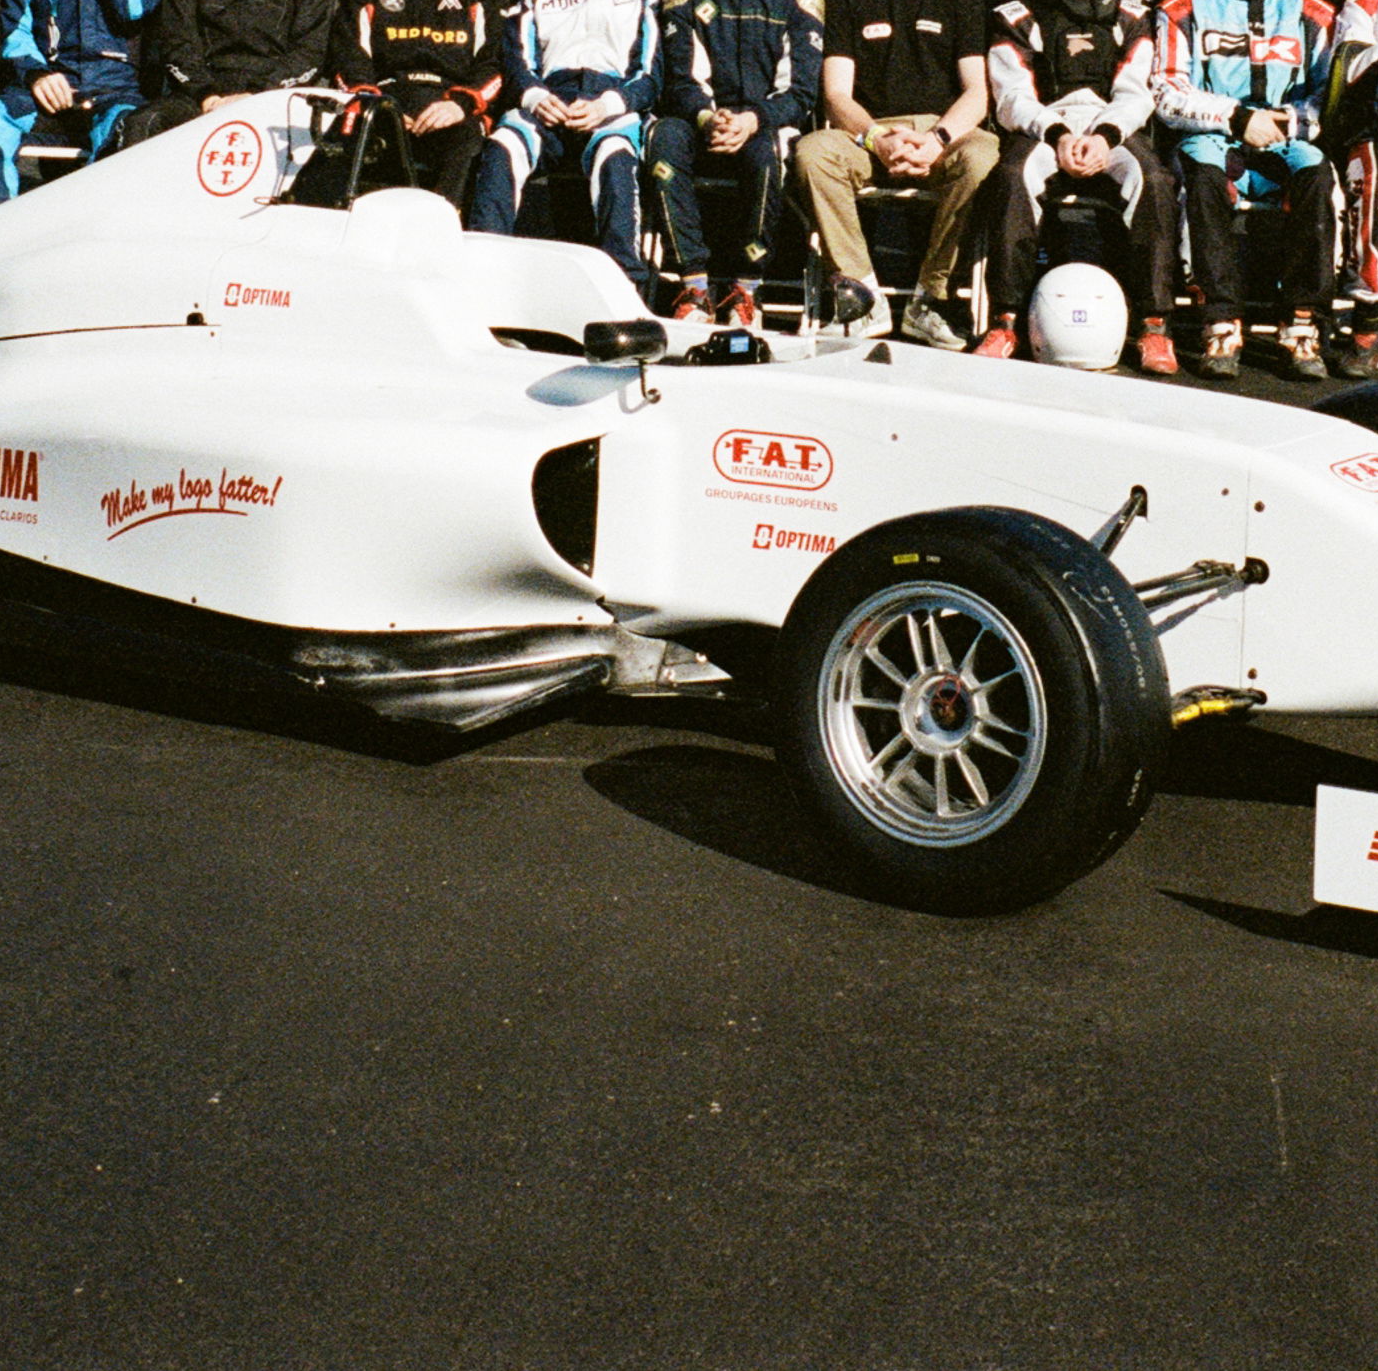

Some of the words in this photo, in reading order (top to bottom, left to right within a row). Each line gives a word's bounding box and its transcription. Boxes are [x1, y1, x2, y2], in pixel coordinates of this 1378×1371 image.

[386, 27, 468, 44] BEDFORD
[242, 287, 291, 308] OPTIMA
[732, 437, 818, 472] F.A.T.
[731, 465, 816, 484] INTERNATIONAL
[101, 480, 147, 527] Make
[152, 482, 174, 514] my
[179, 468, 212, 509] logo
[218, 467, 283, 507] fatter!
[705, 488, 772, 503] GROUPAGES
[0, 510, 38, 524] CLARIOS
[775, 530, 836, 554] OPTIMA
